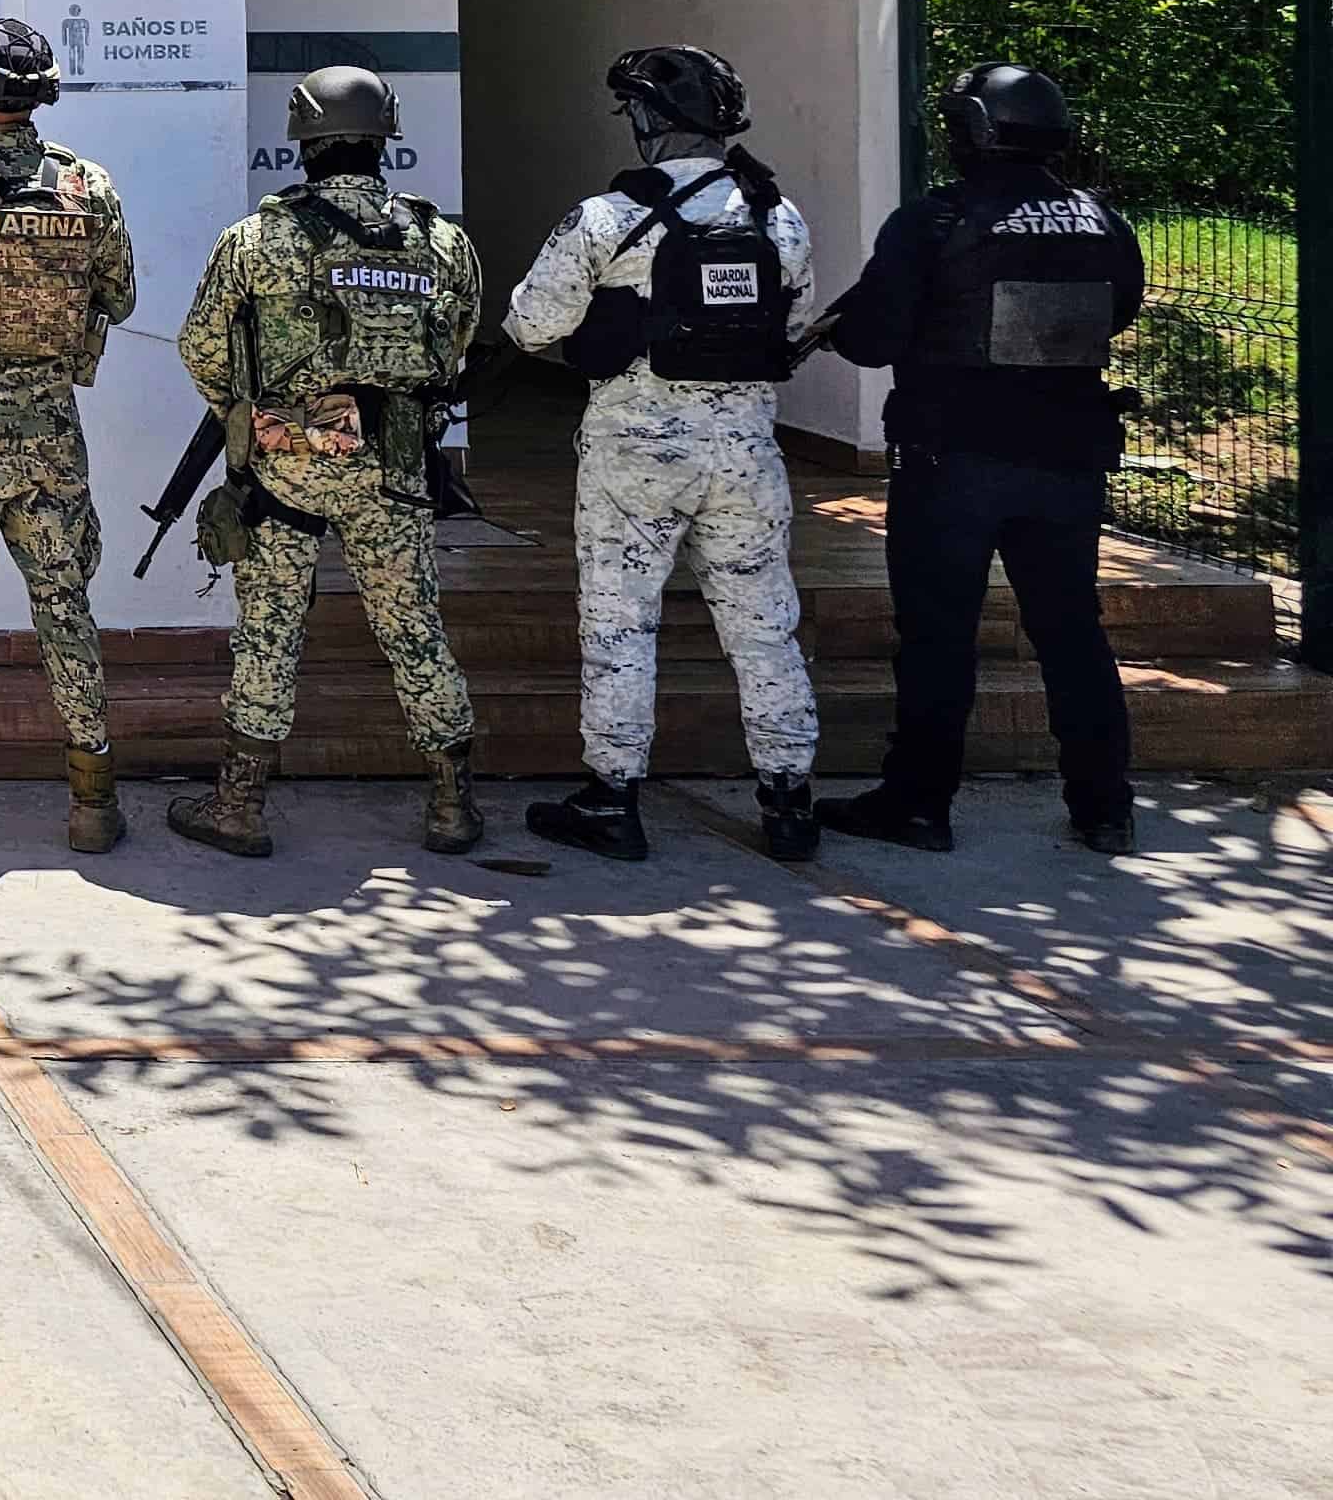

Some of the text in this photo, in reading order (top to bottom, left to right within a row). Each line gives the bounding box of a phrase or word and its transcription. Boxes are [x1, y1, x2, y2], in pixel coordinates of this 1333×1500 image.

[102, 17, 208, 36] BAÑOS DE
[331, 265, 431, 295] EJÉRCITO
[708, 268, 751, 283] GUARDIA
[706, 284, 755, 299] NACIONAL
